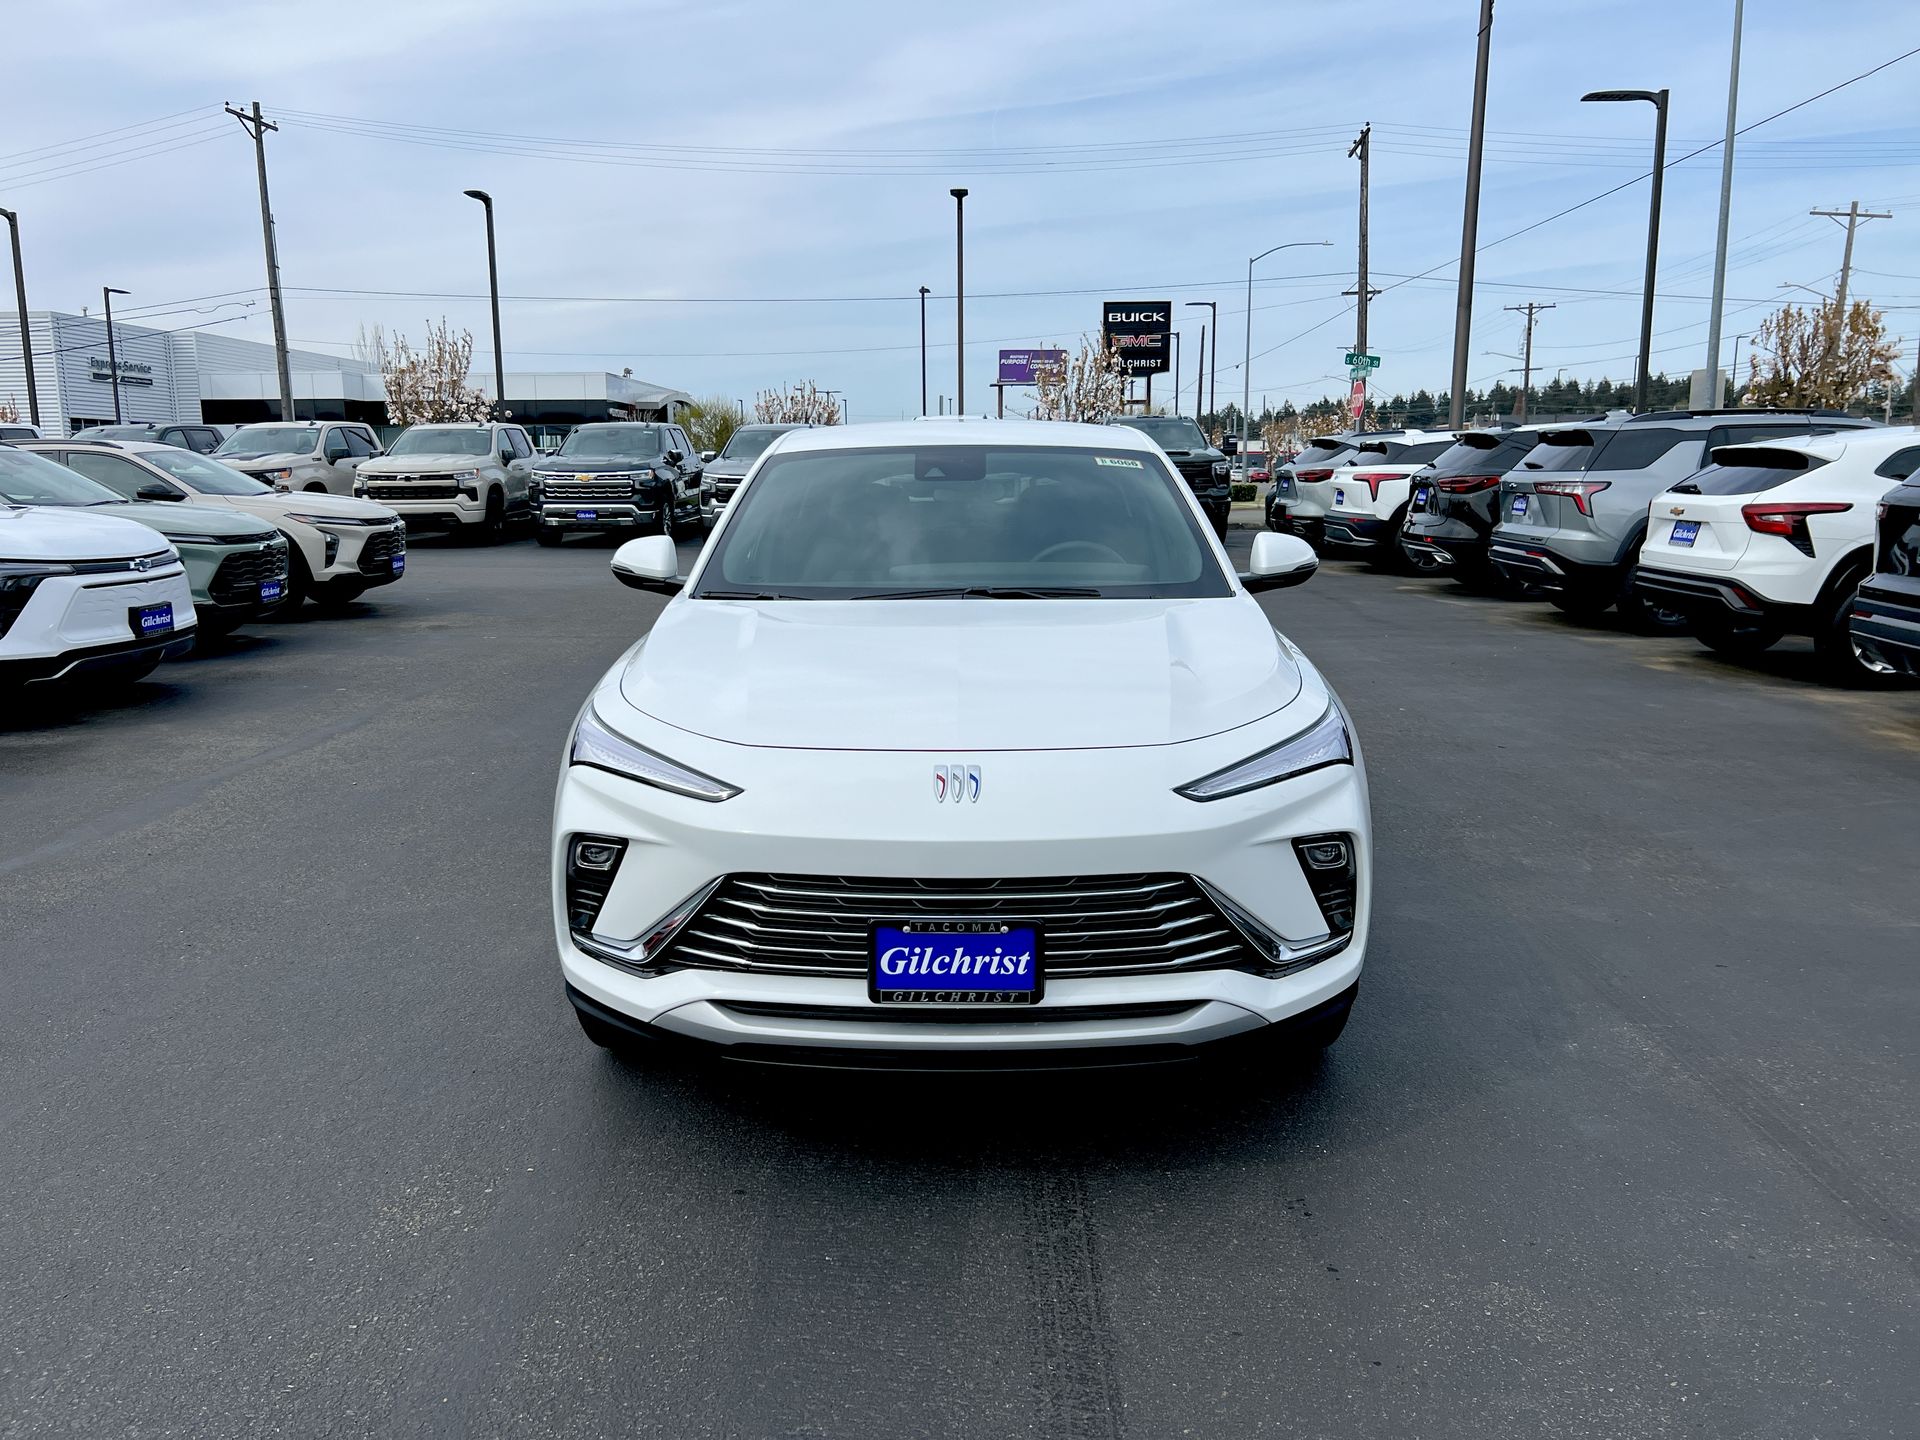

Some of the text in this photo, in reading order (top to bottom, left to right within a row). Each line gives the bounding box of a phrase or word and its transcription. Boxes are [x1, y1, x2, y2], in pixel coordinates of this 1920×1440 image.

[1108, 312, 1165, 322] BUICK
[1112, 335, 1161, 347] GMC
[123, 360, 152, 373] Service
[1117, 359, 1162, 368] ILCHRIST
[1352, 356, 1371, 366] 60th
[141, 613, 171, 628] Gilchrist
[915, 922, 997, 932] TACOMA
[880, 947, 1031, 975] Gilchrist
[892, 991, 1019, 1003] GILCHRIST
